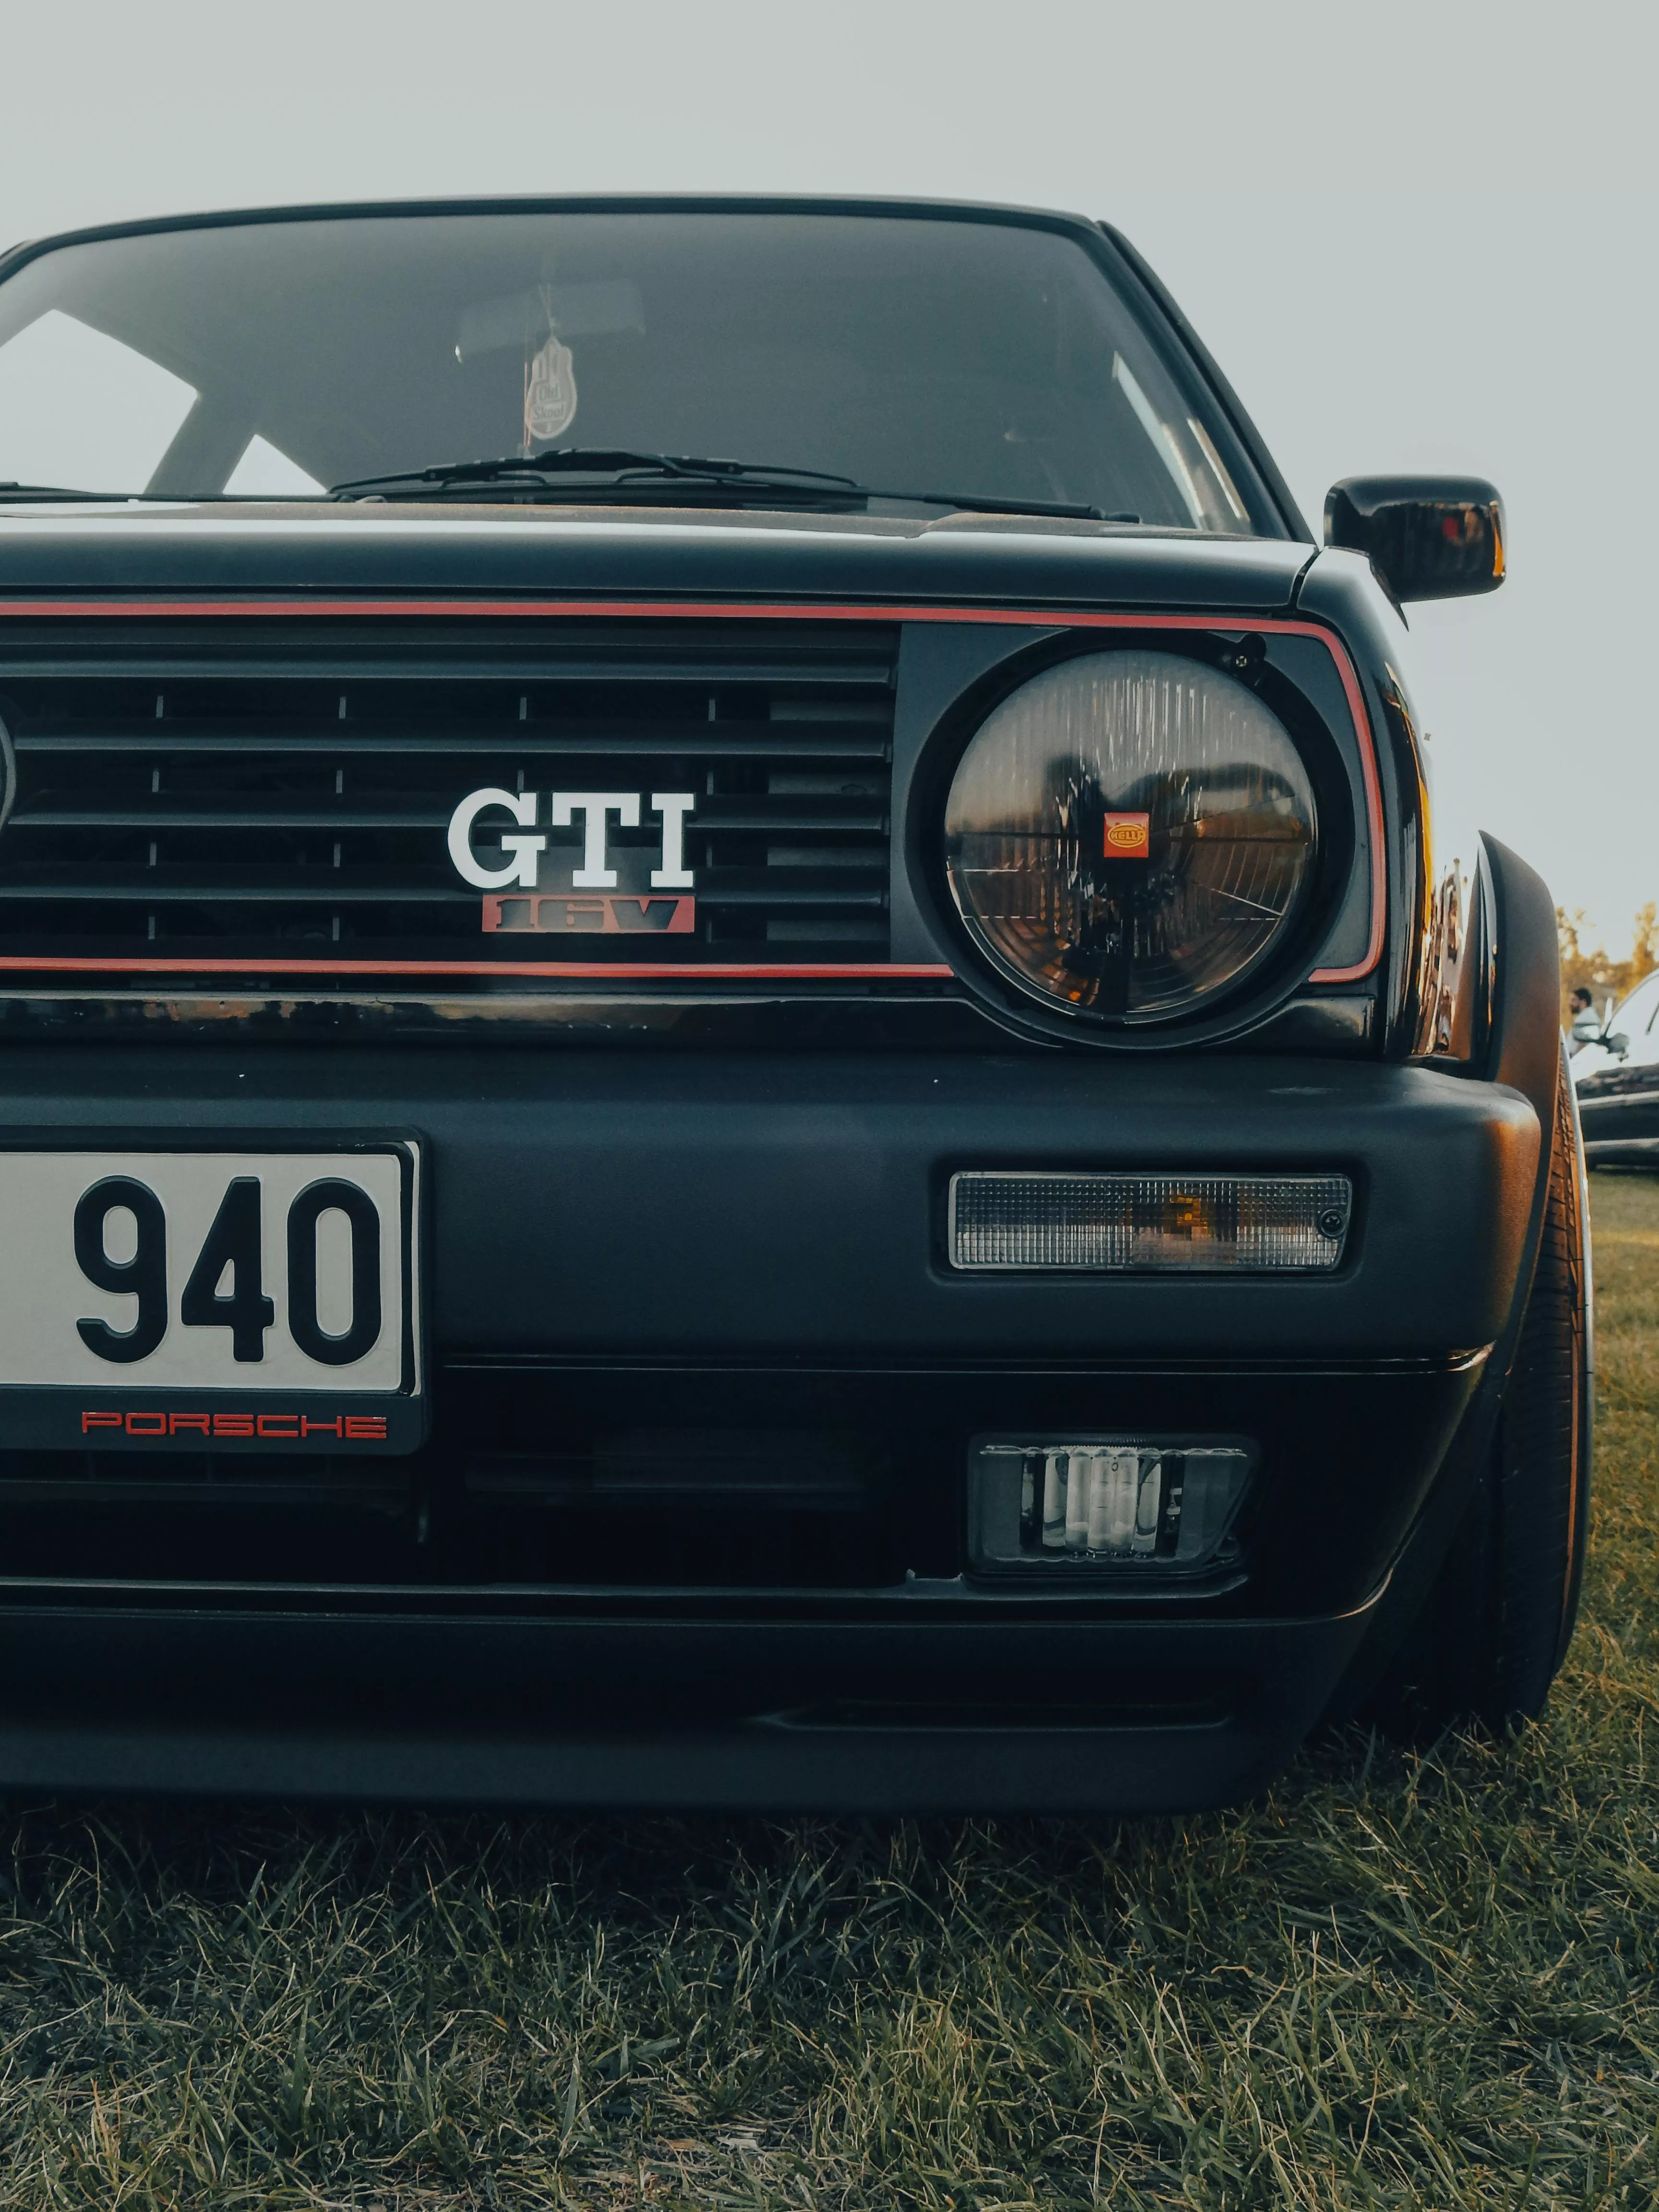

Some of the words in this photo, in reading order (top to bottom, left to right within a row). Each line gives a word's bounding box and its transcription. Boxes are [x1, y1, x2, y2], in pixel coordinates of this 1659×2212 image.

[539, 384, 558, 400] Old
[534, 403, 564, 419] Skool
[447, 788, 695, 889] GTI
[1111, 830, 1145, 842] HELLA
[496, 899, 679, 930] 16V
[74, 1175, 382, 1367] 940
[82, 1412, 387, 1439] PORSCHE
